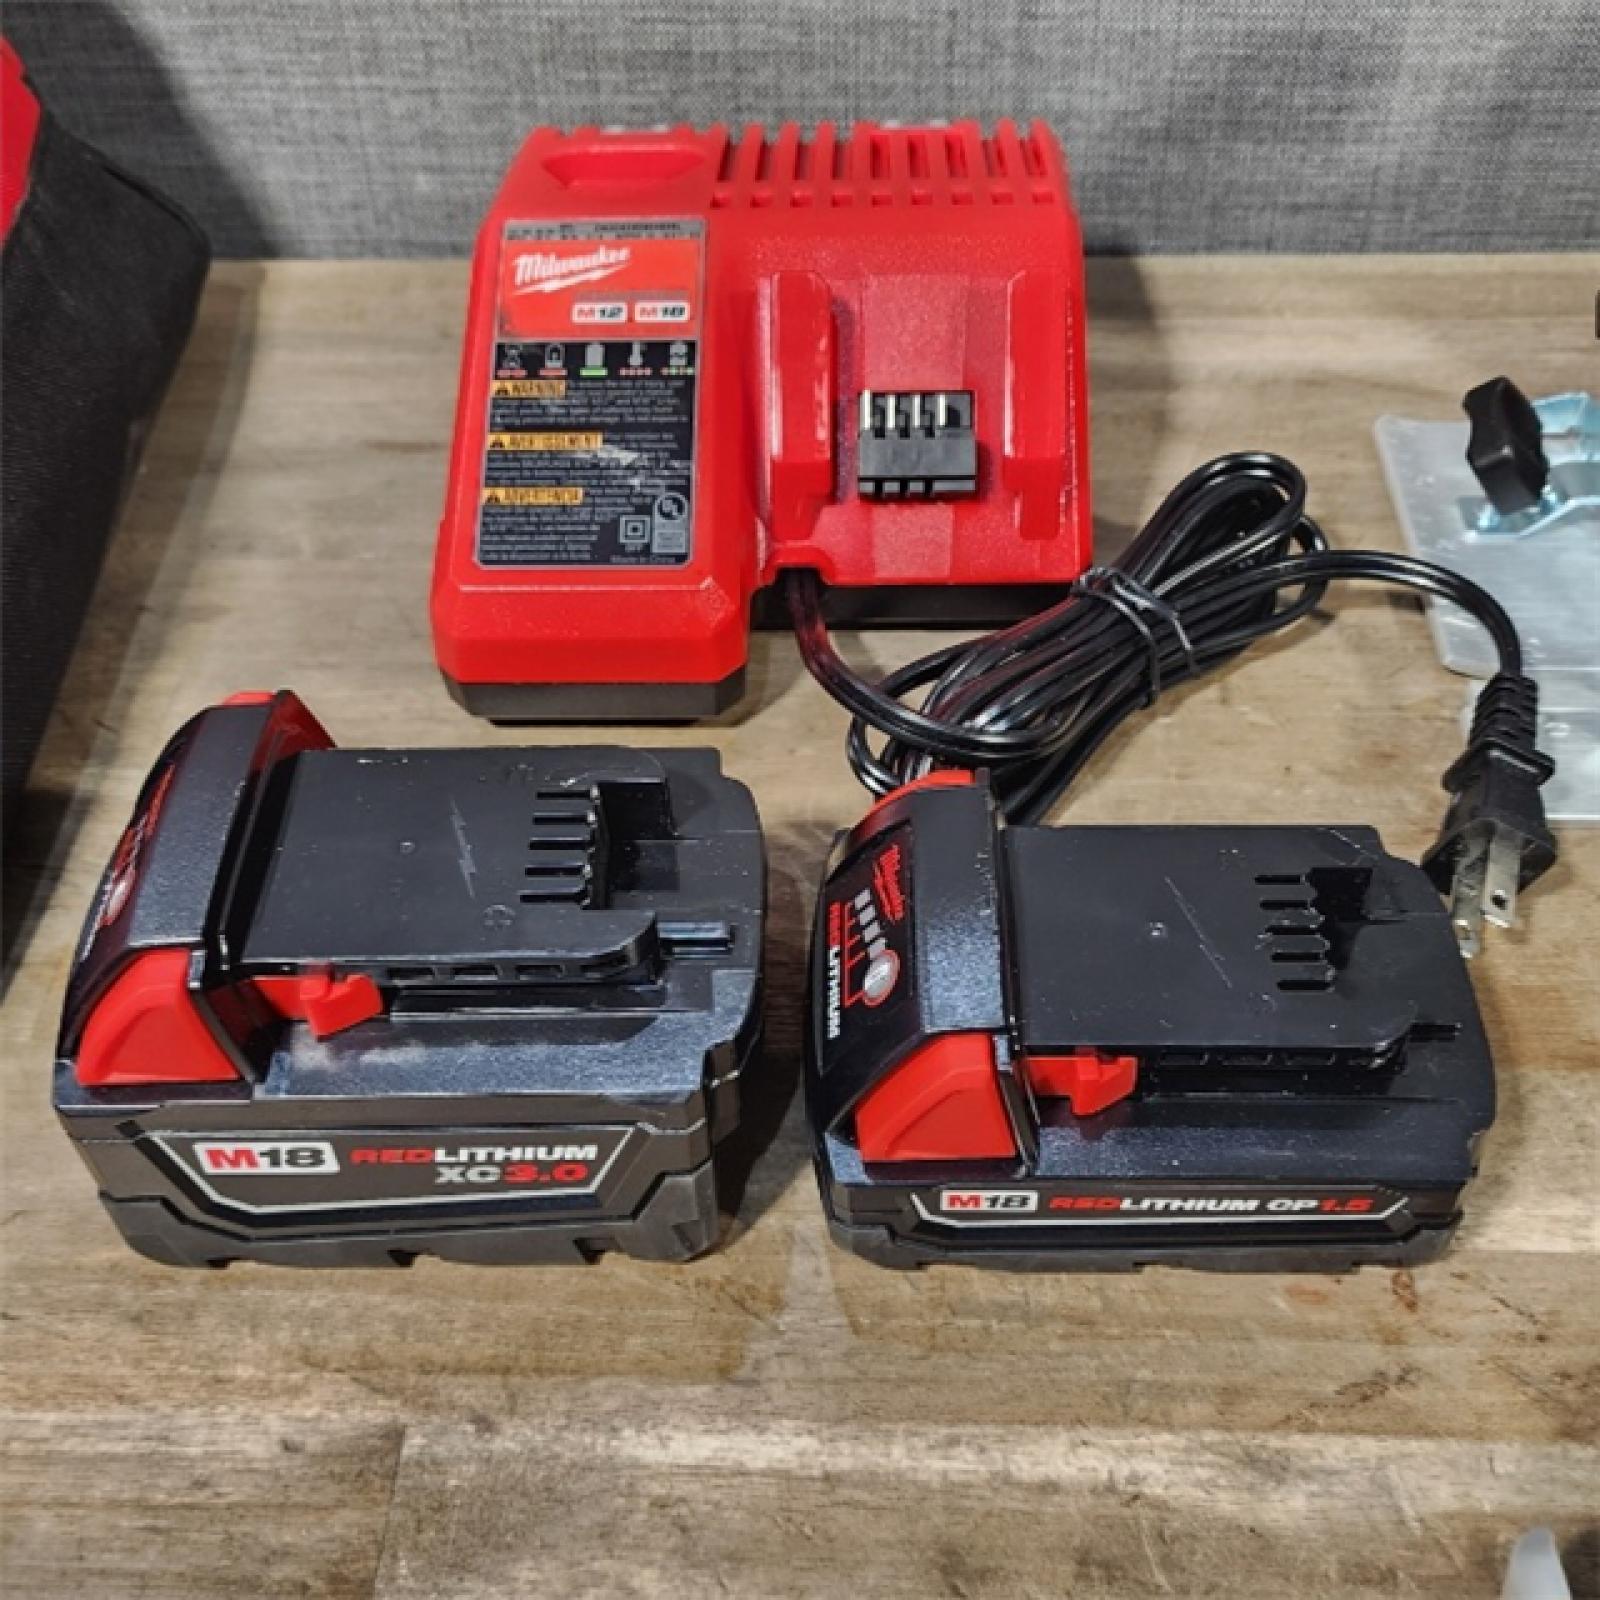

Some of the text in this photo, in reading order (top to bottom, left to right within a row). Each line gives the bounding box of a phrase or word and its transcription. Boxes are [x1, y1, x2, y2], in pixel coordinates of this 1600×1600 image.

[513, 244, 631, 286] Milwaukee
[575, 304, 687, 320] M12 M18
[512, 381, 562, 396] WARNING
[877, 843, 905, 922] Milwaukee
[828, 901, 841, 1040] REDLITHIUM
[204, 1143, 598, 1171] M18 REDLITHIUM
[434, 1162, 589, 1184] XC3.0
[947, 1194, 1031, 1209] M18
[1048, 1197, 1261, 1213] REDLITHIUM
